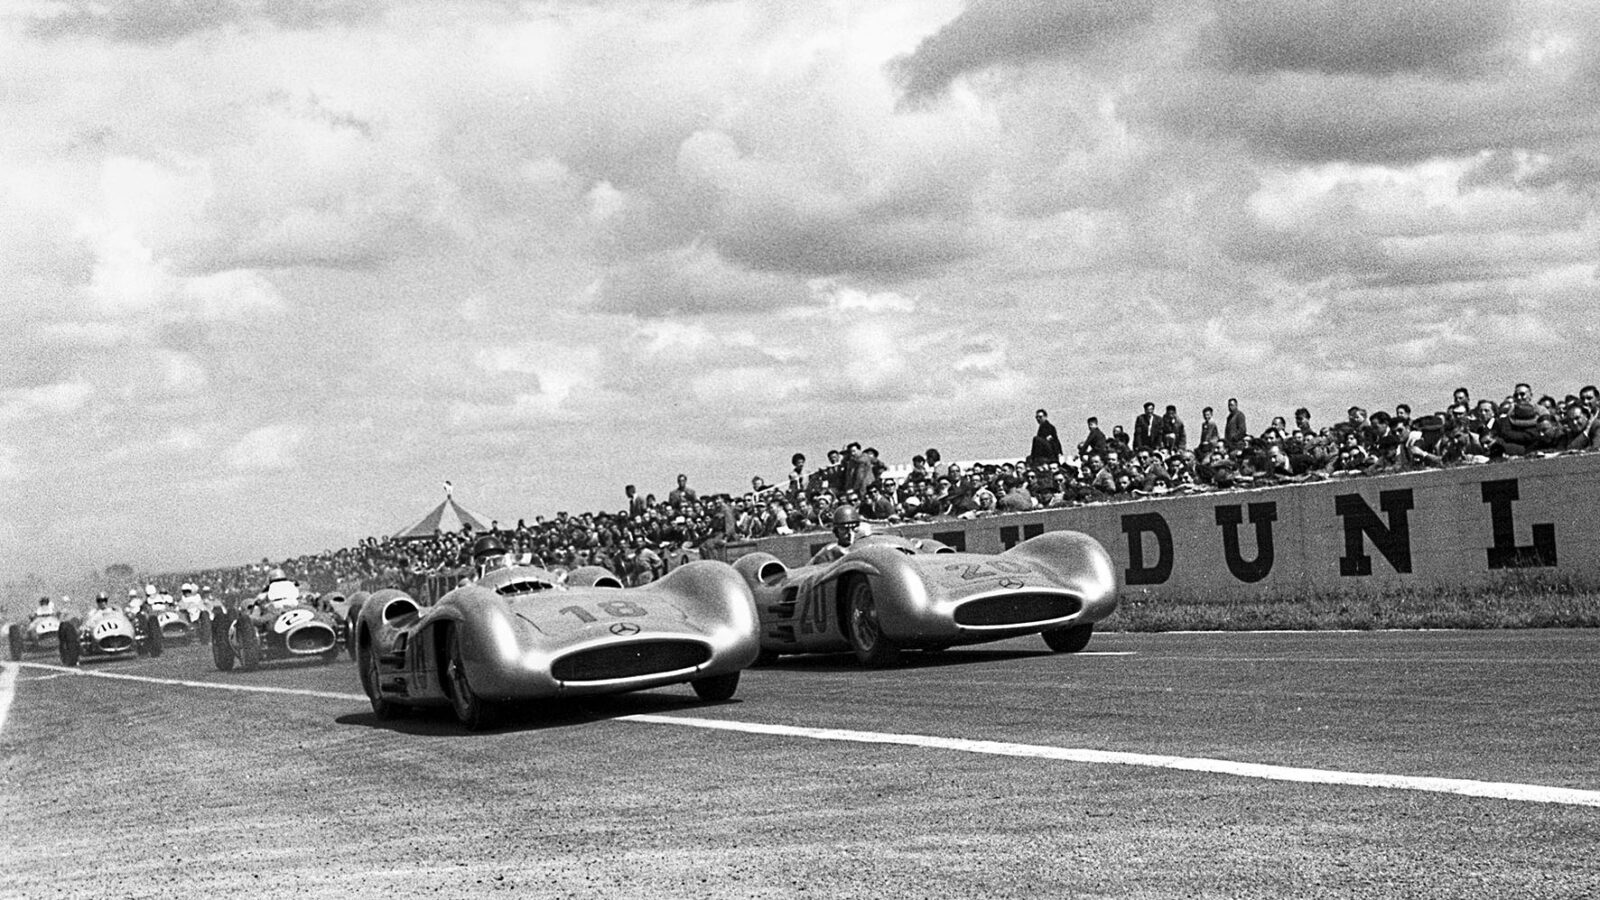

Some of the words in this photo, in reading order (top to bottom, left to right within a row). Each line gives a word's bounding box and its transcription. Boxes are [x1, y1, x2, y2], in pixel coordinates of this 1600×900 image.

[1121, 478, 1557, 585] DUNL
[944, 560, 1032, 580] 20
[558, 600, 648, 623] 18
